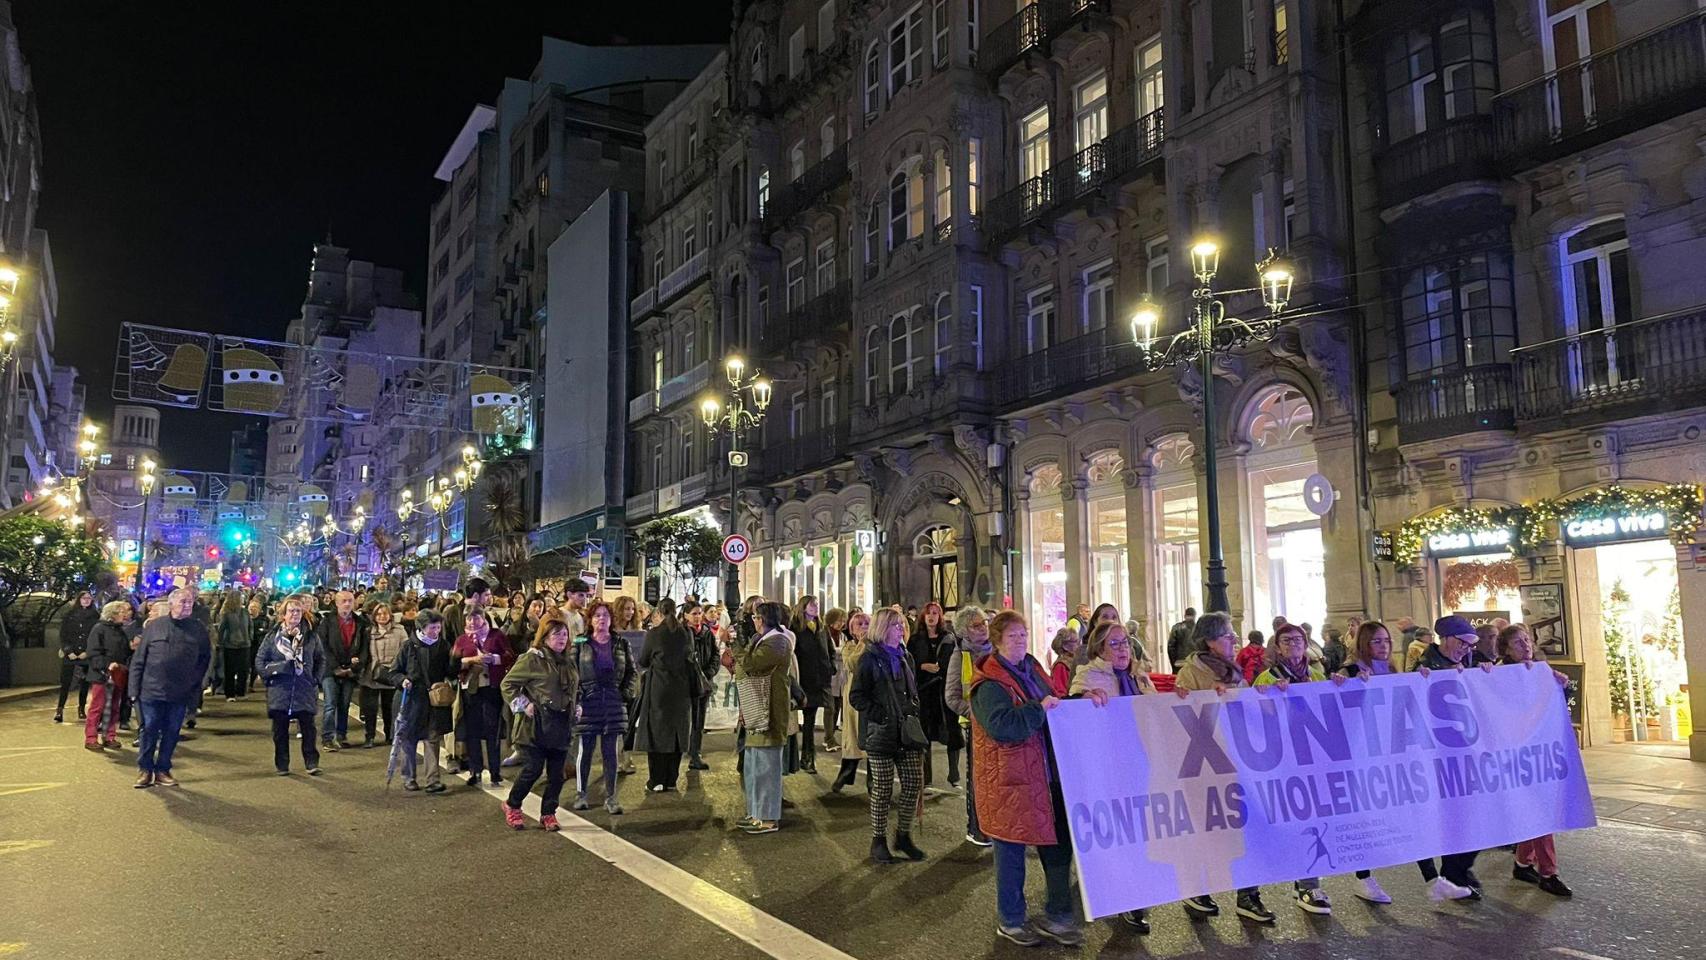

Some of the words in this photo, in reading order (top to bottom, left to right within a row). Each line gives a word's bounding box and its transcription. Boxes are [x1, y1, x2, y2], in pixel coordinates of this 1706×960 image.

[1566, 517, 1616, 538] casa
[1617, 512, 1665, 533] viva
[728, 543, 745, 554] 40
[1374, 536, 1392, 545] casa
[1375, 547, 1392, 556] viva
[1171, 680, 1479, 779] XUNTAS
[1071, 789, 1196, 854] CONTRA
[1205, 782, 1248, 832] AS
[1254, 760, 1430, 825] VIOLENCIAS
[1433, 740, 1569, 799] MACHISTAS
